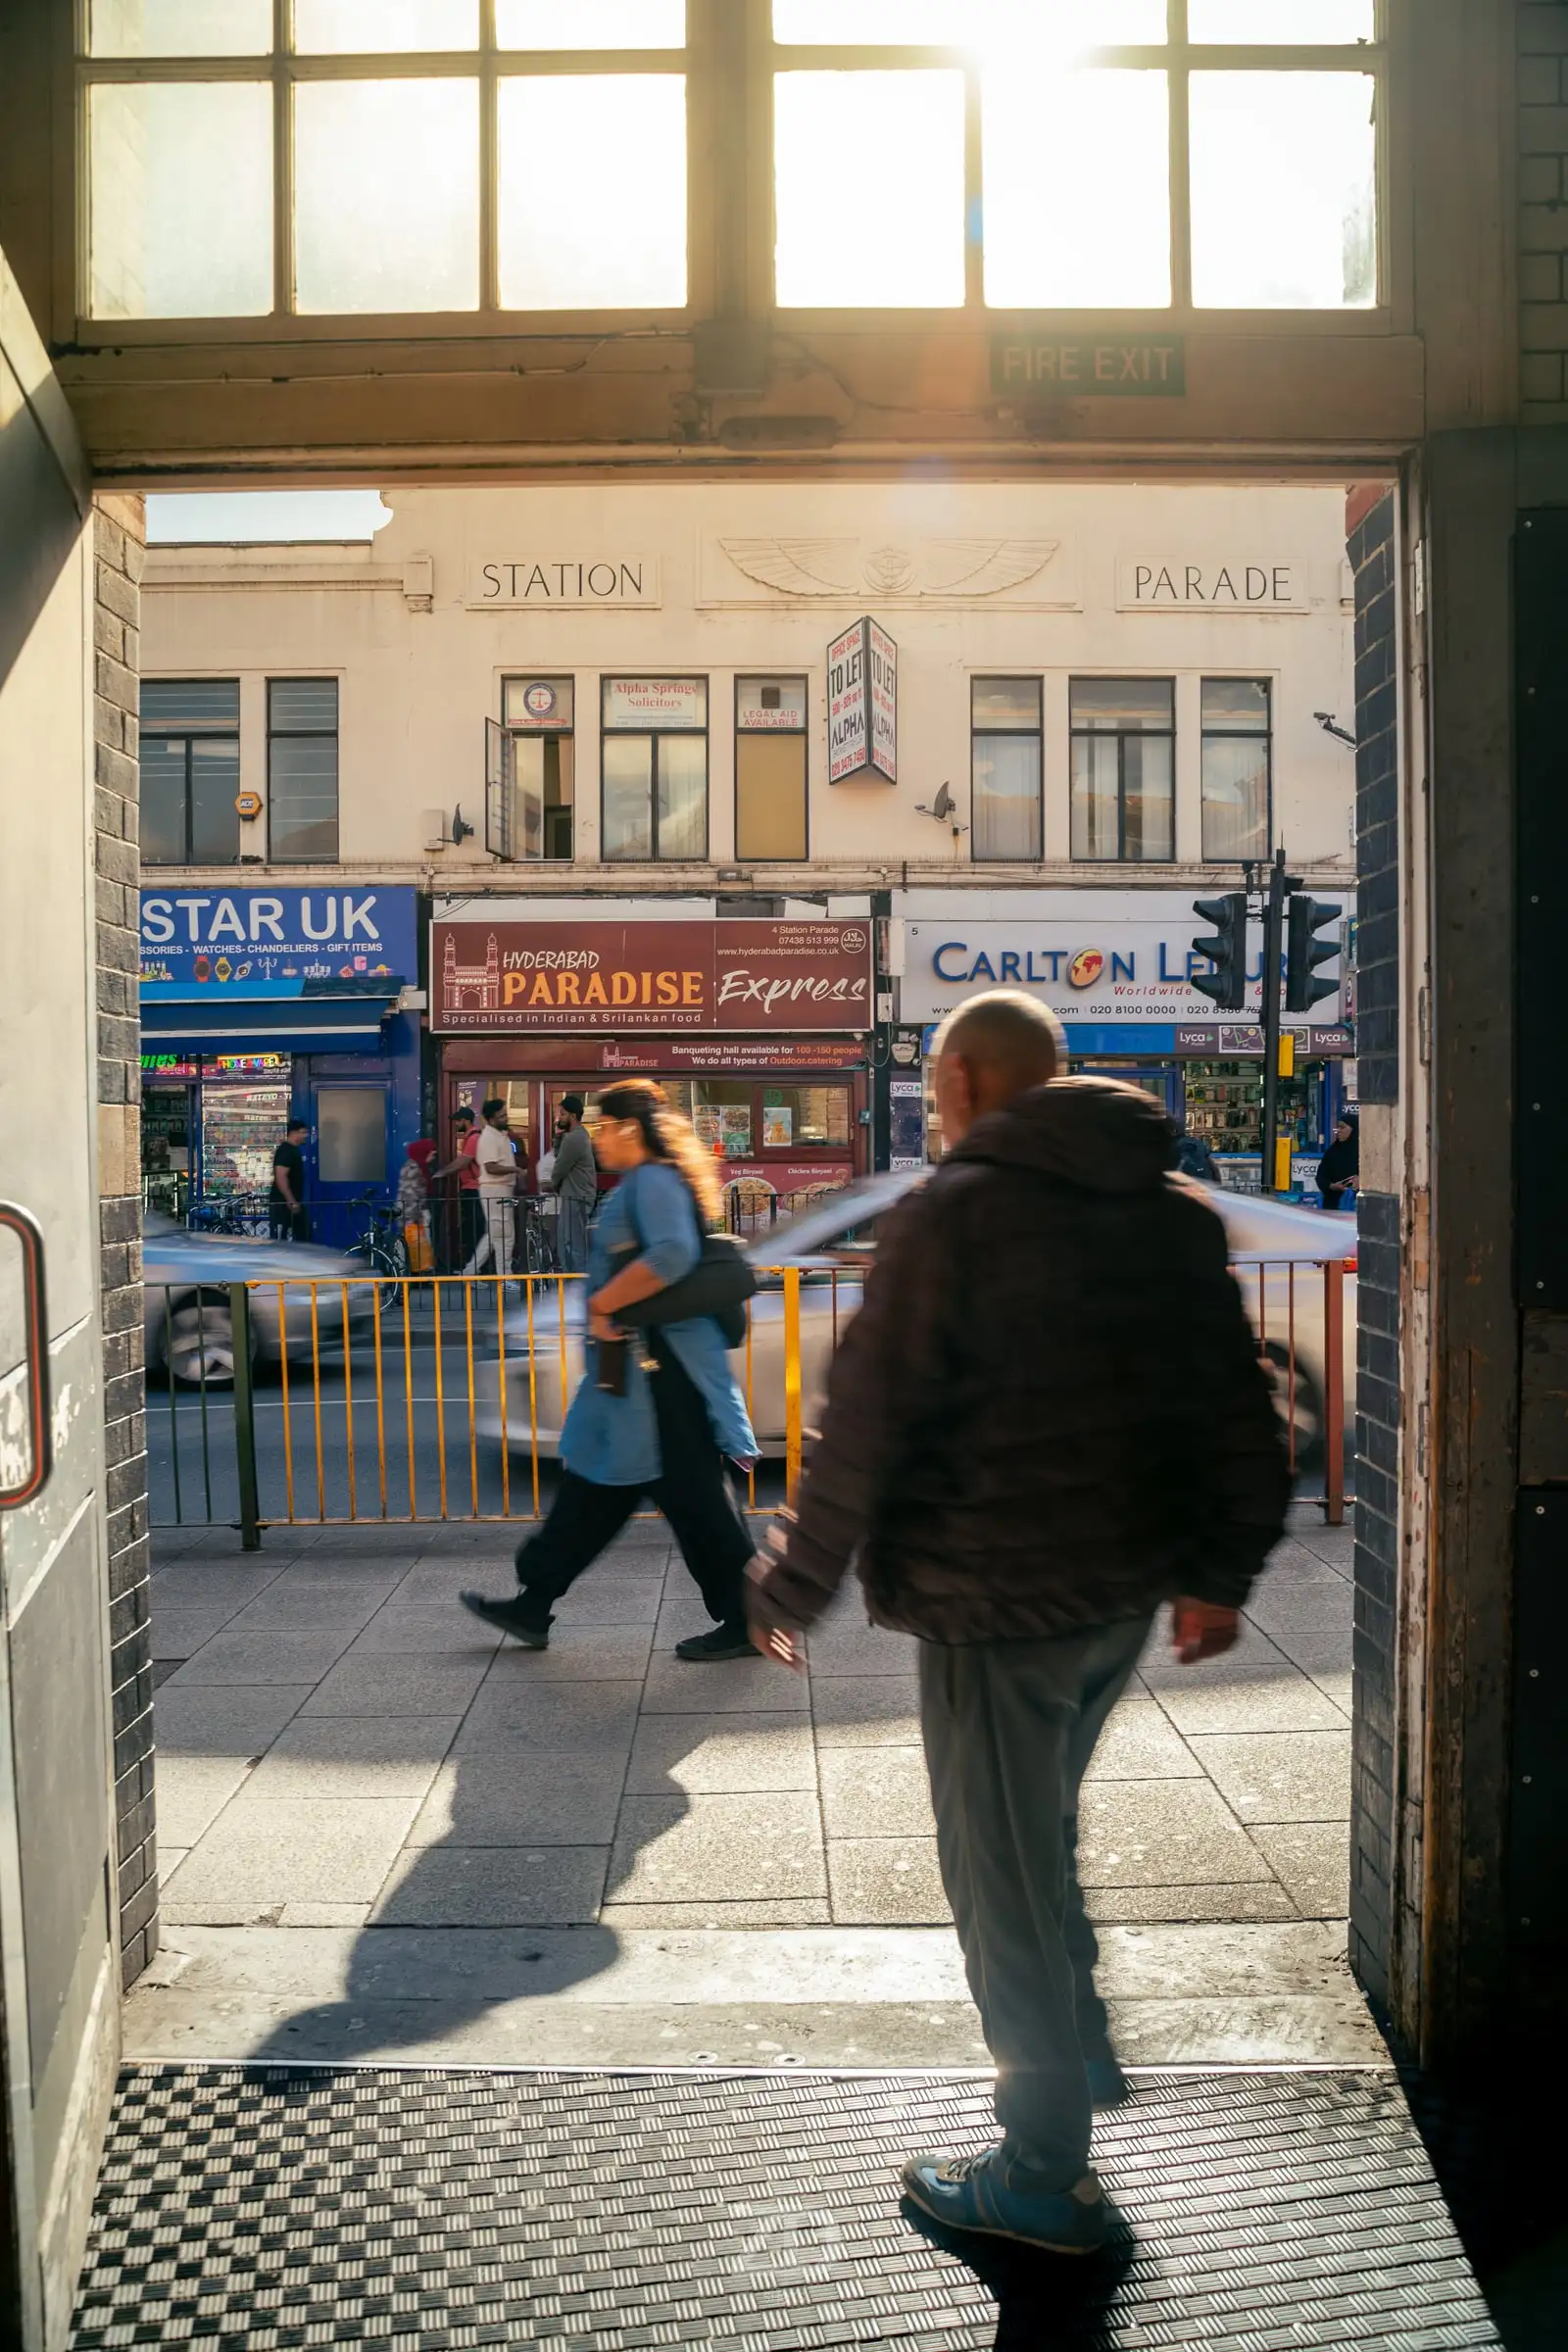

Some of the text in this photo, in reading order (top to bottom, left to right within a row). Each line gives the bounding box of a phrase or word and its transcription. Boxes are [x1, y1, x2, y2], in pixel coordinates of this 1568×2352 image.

[1003, 346, 1174, 381] FIRE EXIT
[482, 564, 642, 598] STATION
[1136, 565, 1292, 601] PARADE
[830, 649, 862, 698] TO LET
[871, 649, 895, 698] TO LET
[615, 683, 697, 696] Alpha Springs
[628, 698, 682, 708] Solicitors
[831, 710, 864, 749] ALPHA
[873, 710, 895, 749] ALPHA
[141, 896, 379, 942] STAR UK
[247, 944, 318, 954] CHANDELIERS
[326, 944, 350, 953] GIFT
[352, 943, 383, 952] ITEMS
[717, 947, 839, 957] www.hyderabadparadise.co.uk
[503, 951, 600, 969] HYDERABAD
[503, 971, 704, 1005] PARADISE
[717, 969, 866, 1014] Express
[1114, 986, 1192, 996] Worldwide
[1090, 1005, 1111, 1014] 020
[1115, 1005, 1143, 1014] 8100
[1146, 1005, 1176, 1014] 0000
[1187, 1005, 1208, 1014] 020
[442, 1012, 701, 1024] Specialised in Indian & Srilankan food
[1180, 1032, 1205, 1044] Lyca
[1315, 1032, 1341, 1044] Lyca
[672, 1046, 721, 1055] Banqueting
[741, 1046, 779, 1054] available
[832, 1047, 862, 1055] people
[733, 1057, 757, 1066] types
[891, 1083, 914, 1092] Lyca
[1293, 1163, 1317, 1174] Lyca
